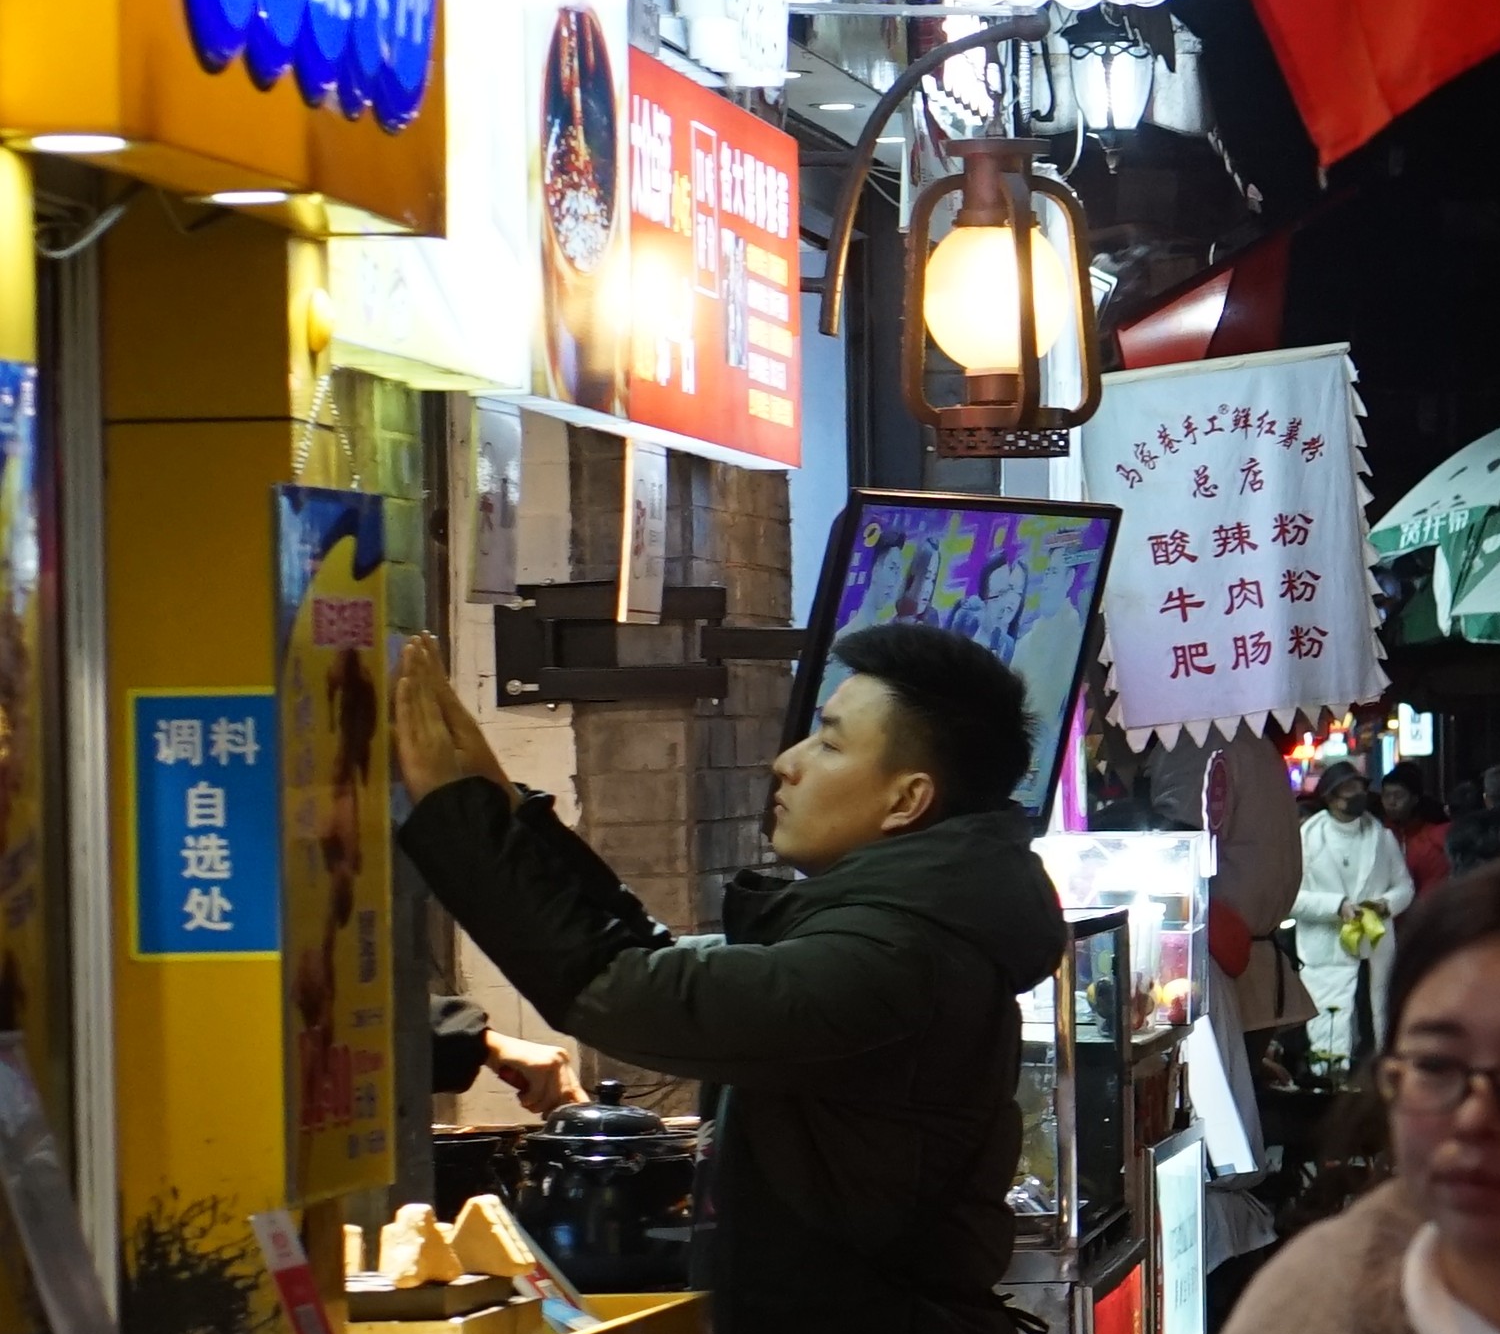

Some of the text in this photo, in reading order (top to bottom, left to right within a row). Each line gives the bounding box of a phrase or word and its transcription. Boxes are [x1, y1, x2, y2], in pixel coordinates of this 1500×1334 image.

[1192, 457, 1265, 499] 总店
[1147, 512, 1314, 566] 酸辣粉
[1159, 568, 1322, 623] 牛肉粉
[1169, 624, 1330, 680] 肥肠粉
[154, 718, 261, 768] 调料
[182, 779, 235, 935] 自选处
